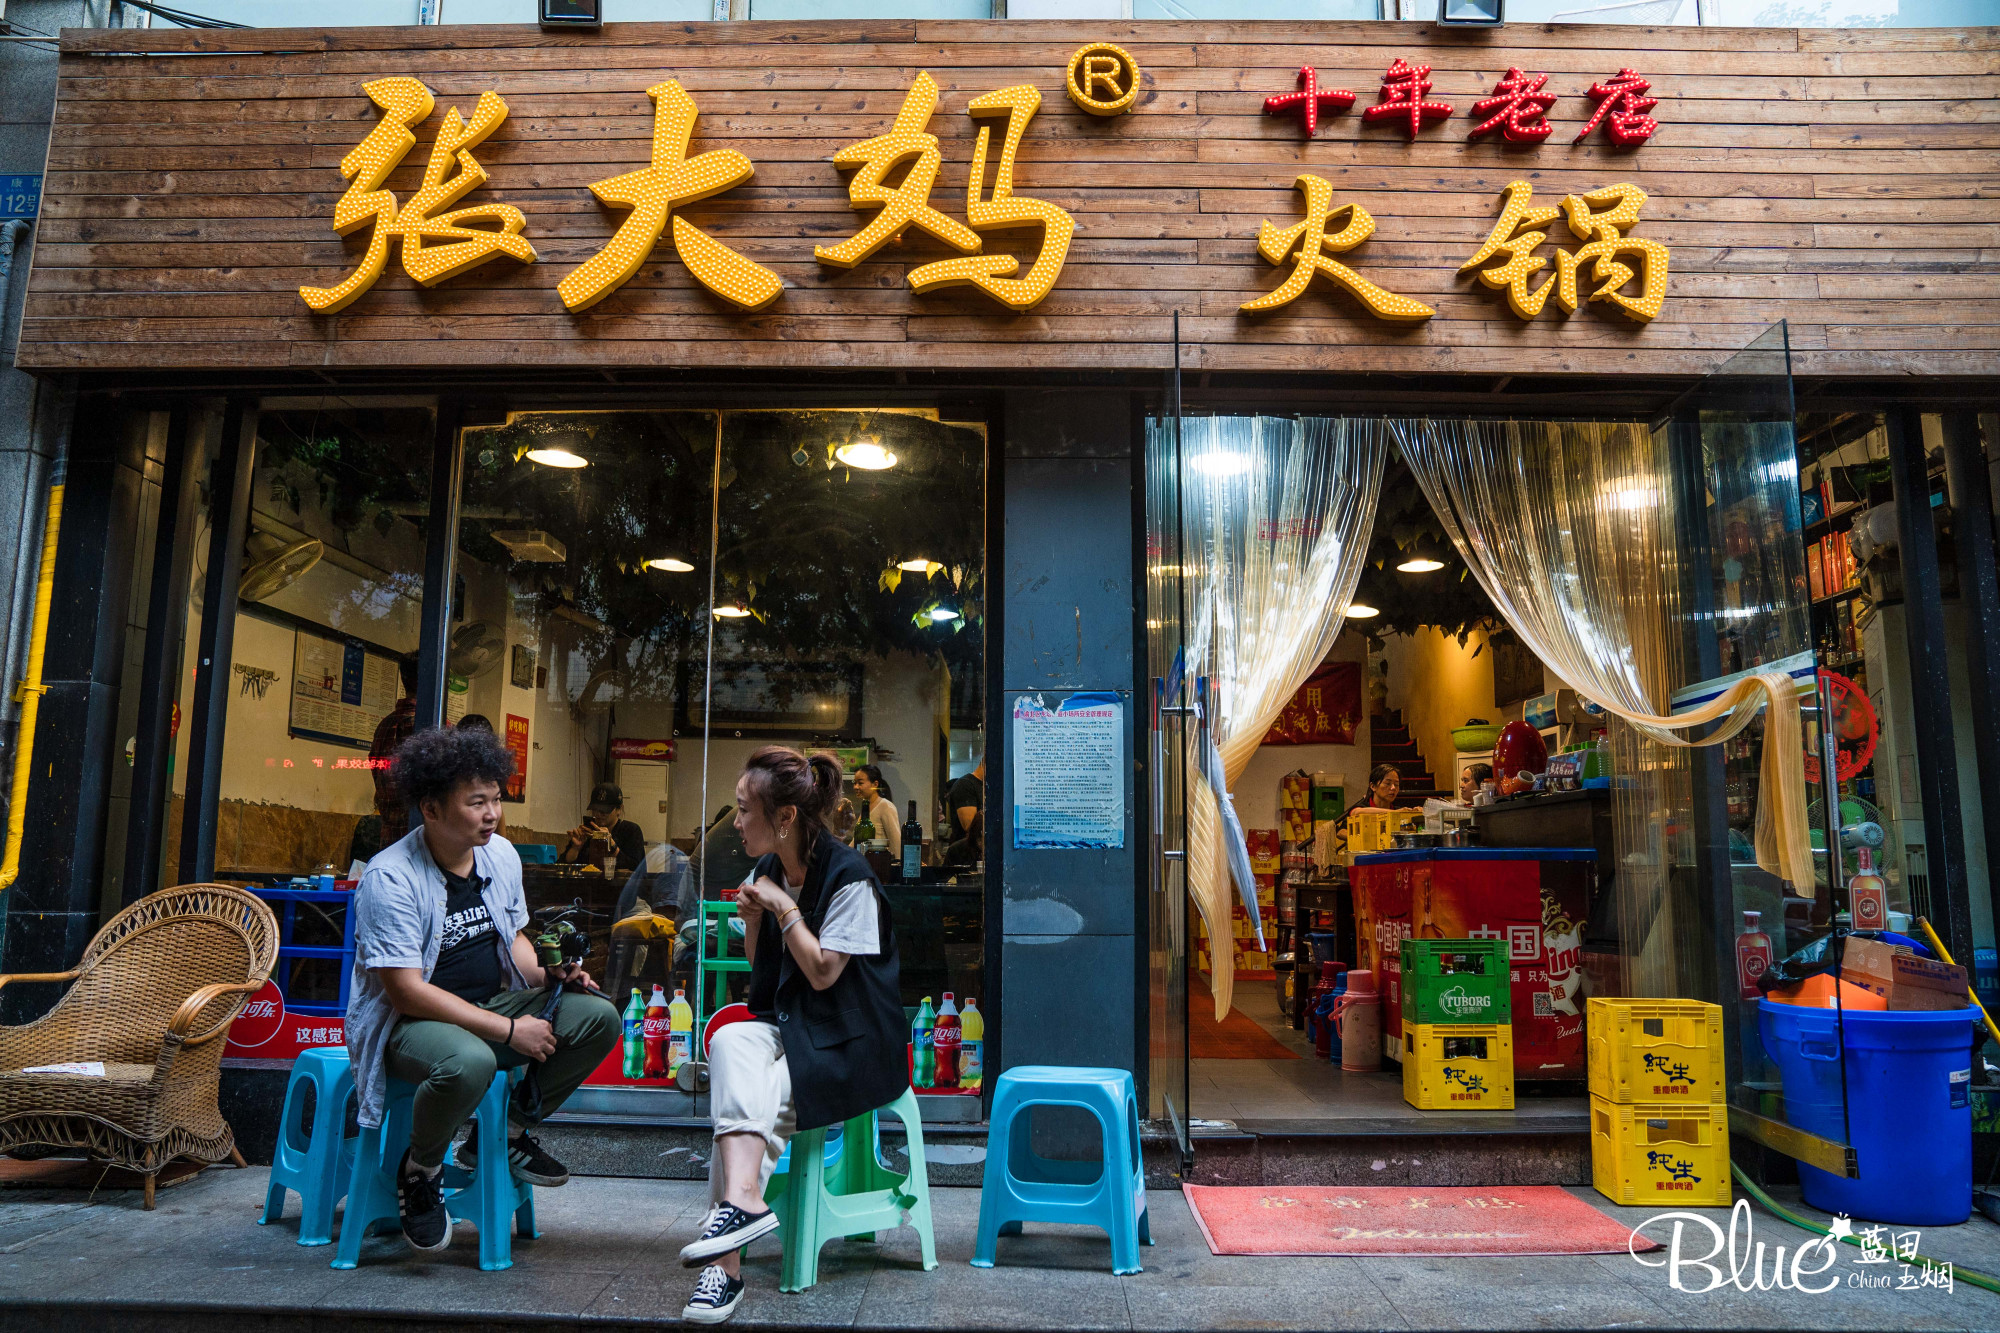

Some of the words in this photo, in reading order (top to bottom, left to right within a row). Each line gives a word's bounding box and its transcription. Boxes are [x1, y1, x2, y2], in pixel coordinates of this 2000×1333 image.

[1262, 58, 1660, 148] 十年老店
[299, 70, 1075, 314] 张大妈
[1239, 174, 1671, 323] 火锅
[1447, 995, 1491, 1008] TUBORG
[296, 1027, 343, 1044] 这感觉
